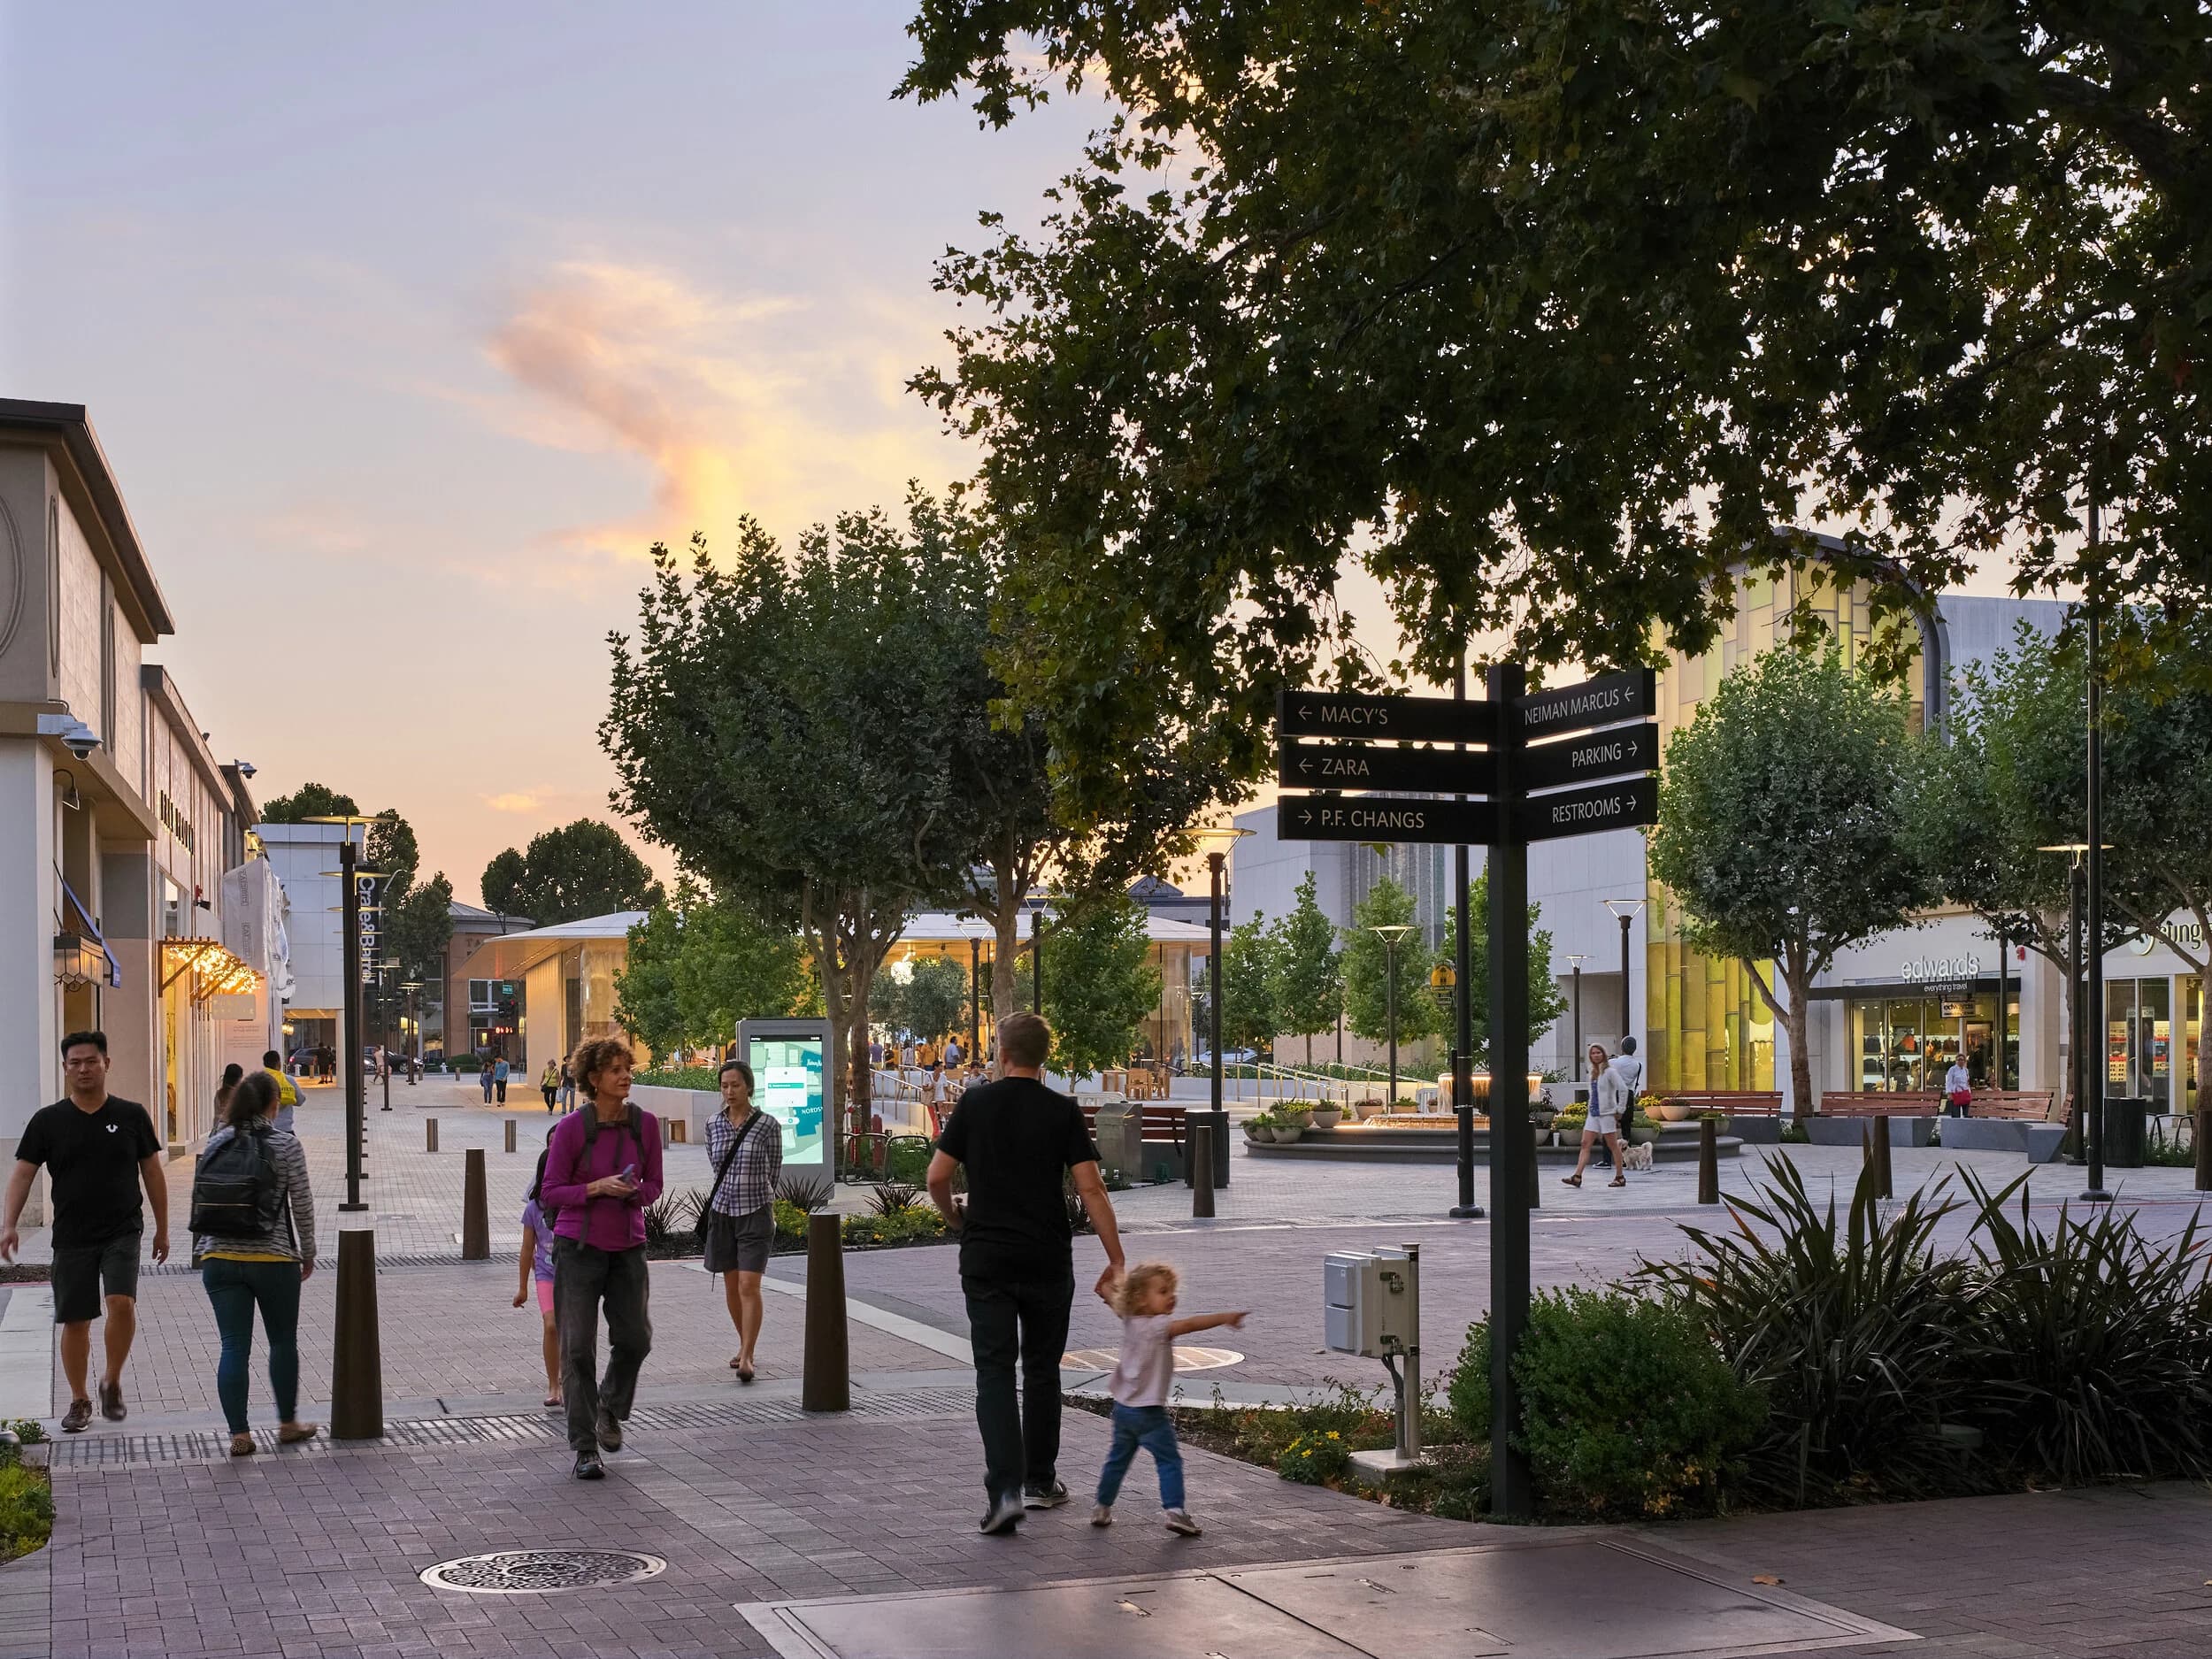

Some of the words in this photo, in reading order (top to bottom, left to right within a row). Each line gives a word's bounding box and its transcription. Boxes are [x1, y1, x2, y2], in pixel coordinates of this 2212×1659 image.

[1321, 706, 1388, 725] MACY'S
[1525, 700, 1568, 726] NEIMAN
[1571, 688, 1619, 715] MARCUS
[1571, 742, 1622, 768] PARKING
[1321, 758, 1371, 776] ZARA
[1321, 810, 1346, 826] P.F.
[1350, 810, 1425, 829] CHANGS
[1552, 796, 1621, 824] RESTROOMS
[1901, 952, 1979, 979] edwards
[1924, 983, 1952, 993] everything
[1952, 982, 1968, 991] travel
